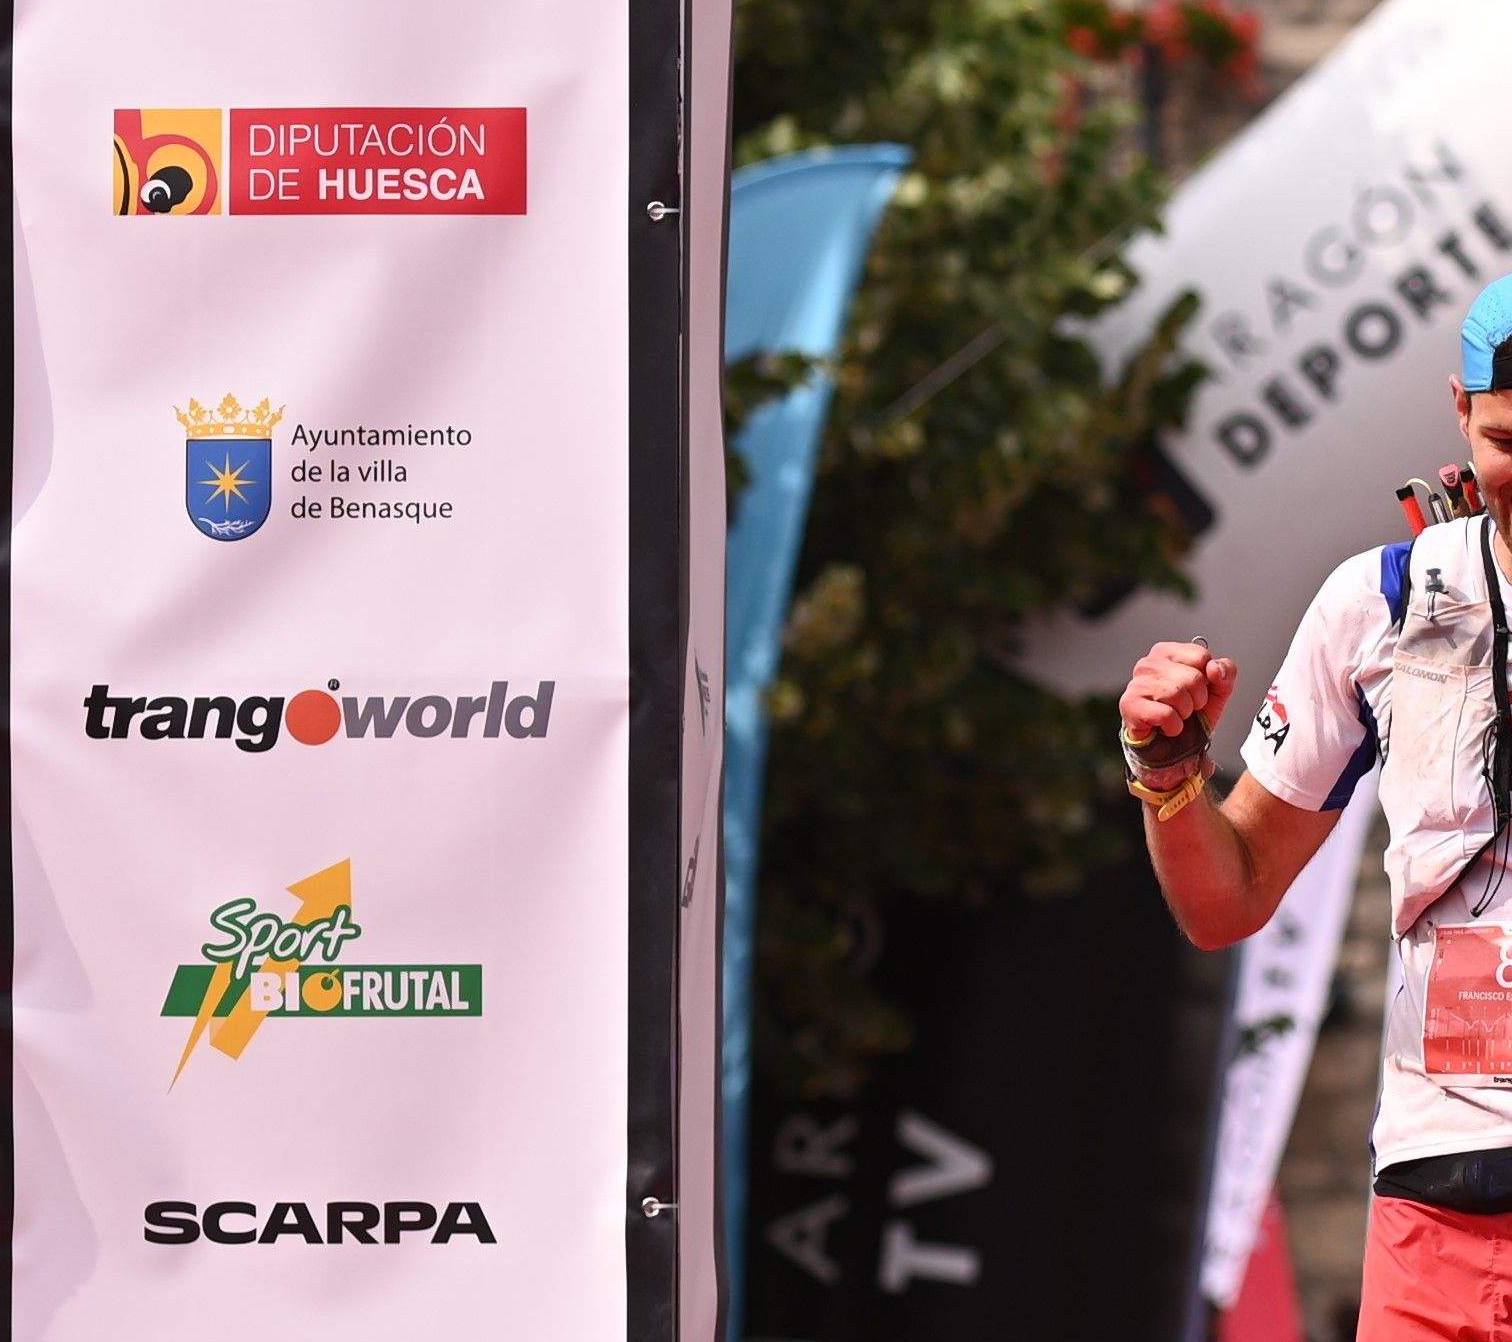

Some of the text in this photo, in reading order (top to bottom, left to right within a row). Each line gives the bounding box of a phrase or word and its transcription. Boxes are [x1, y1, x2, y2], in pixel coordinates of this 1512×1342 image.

[250, 117, 485, 157] DIPUTACIÓN
[250, 167, 485, 200] DE HUESCA
[292, 424, 471, 450] Ayuntamiento
[291, 460, 407, 483] de la villa
[291, 496, 453, 524] de Benasque
[83, 679, 555, 753] trangoworld
[201, 898, 361, 979] Sport
[250, 968, 470, 1013] BIOFRUTAL
[1458, 991, 1504, 1001] FRANCISCO
[144, 1201, 497, 1245] SCARPA
